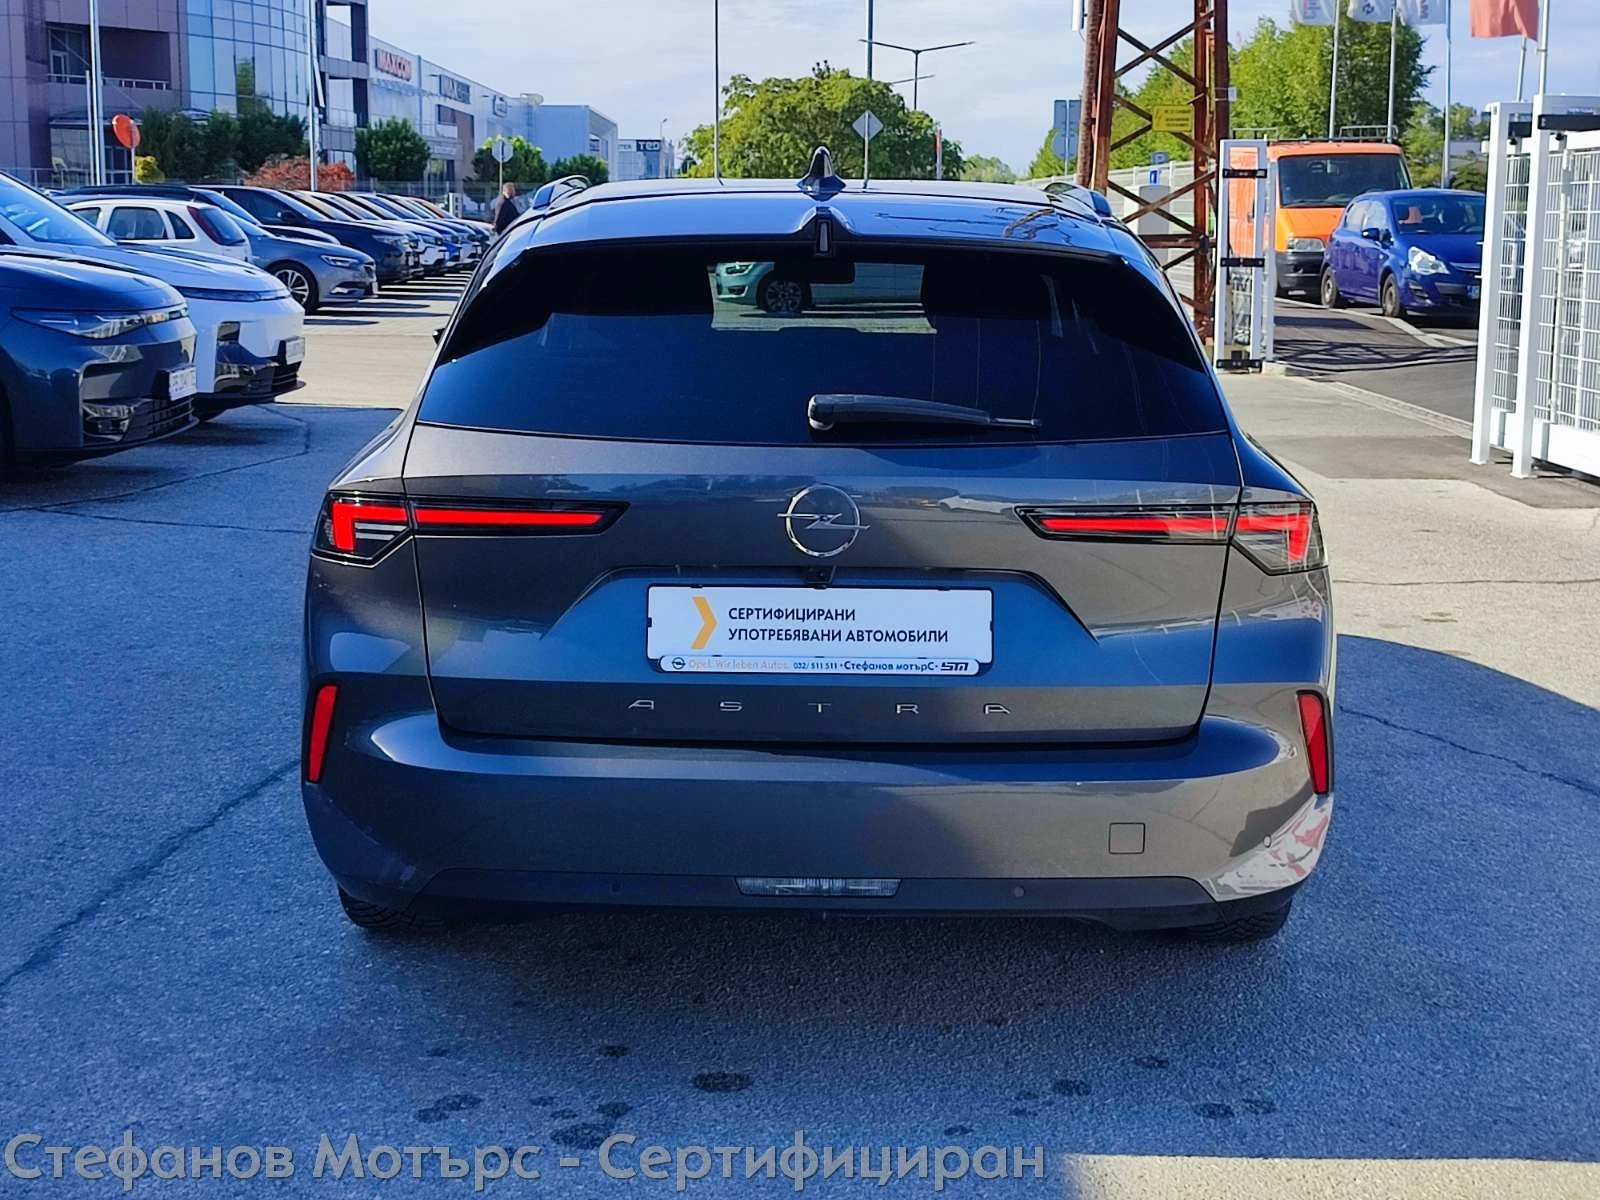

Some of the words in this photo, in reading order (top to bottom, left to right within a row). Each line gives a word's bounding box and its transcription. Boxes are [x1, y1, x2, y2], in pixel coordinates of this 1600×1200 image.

[728, 607, 856, 623] СЕРТИФИЦИРАНИ
[728, 628, 842, 643] УПОТРЕБЯВАНИ
[845, 629, 949, 644] АВТОМОБИЛИ
[628, 699, 1011, 715] ASTRA
